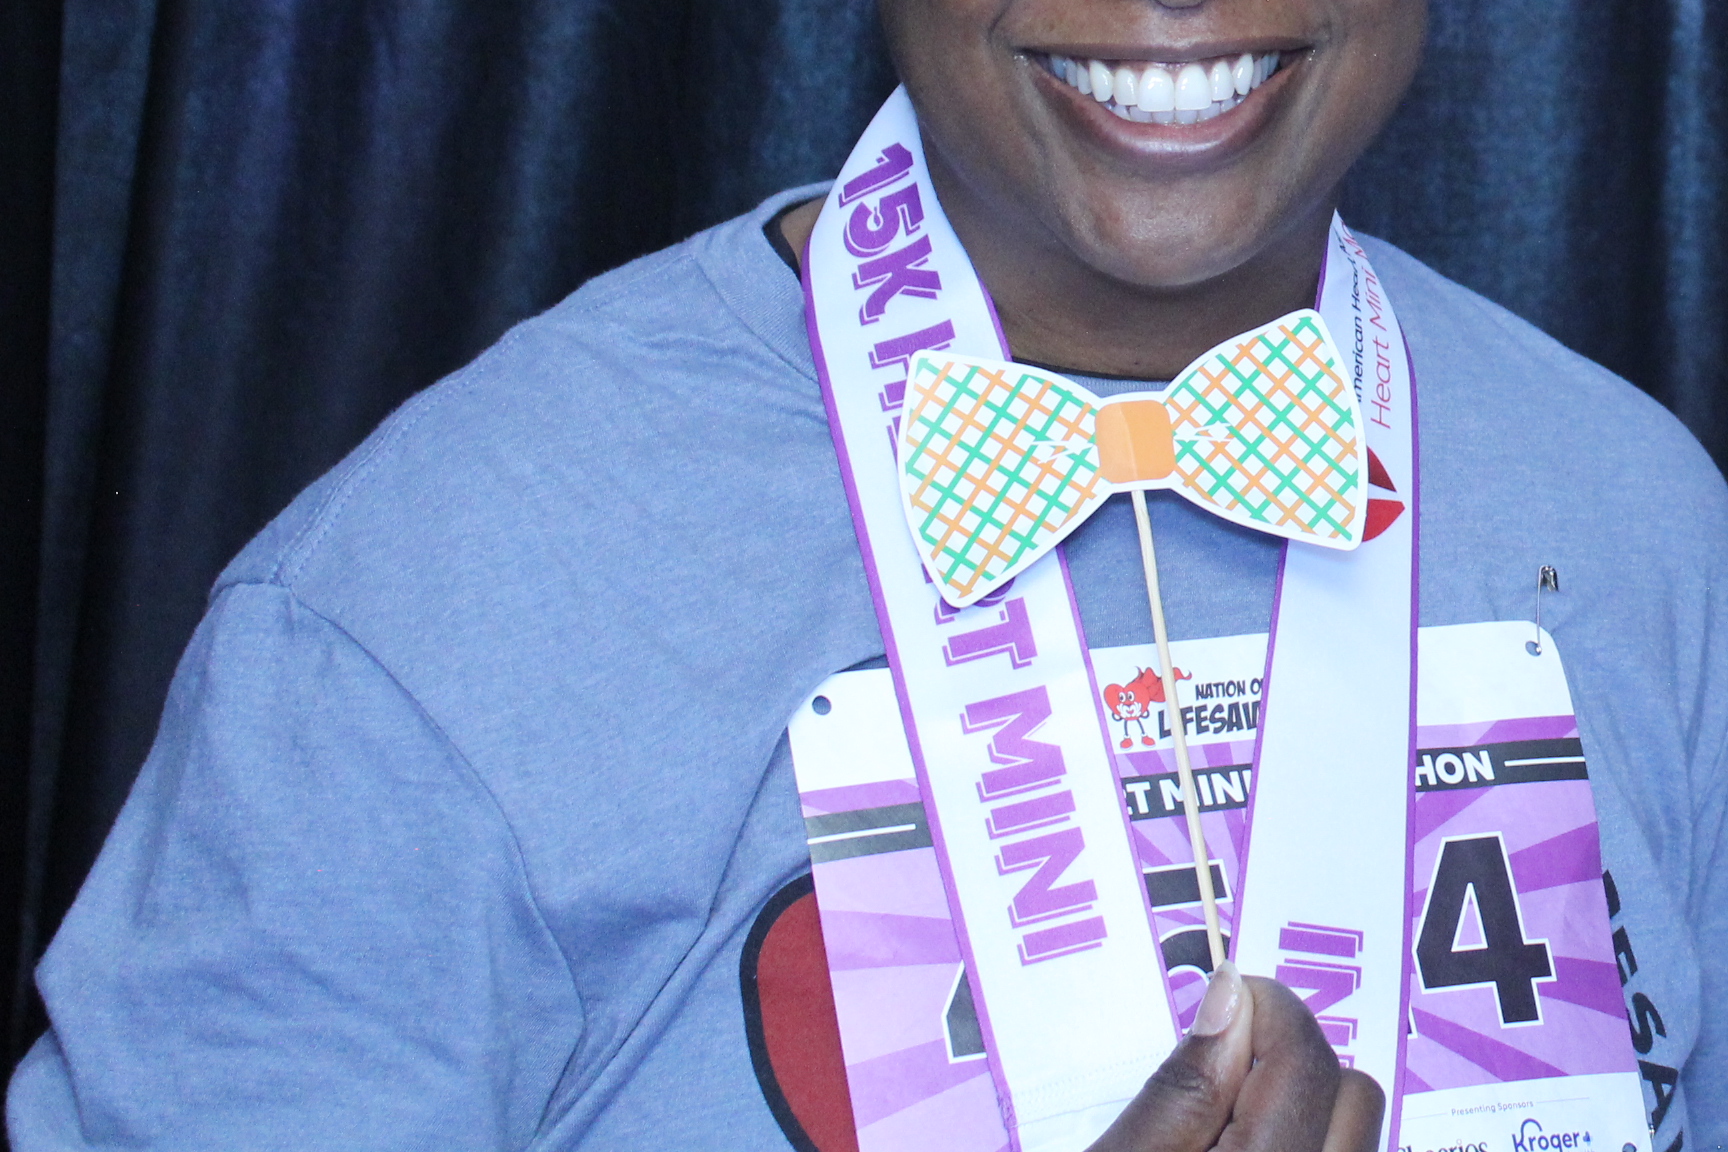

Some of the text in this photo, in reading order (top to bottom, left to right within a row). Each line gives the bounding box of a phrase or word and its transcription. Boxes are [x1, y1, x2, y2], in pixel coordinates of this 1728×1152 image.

[838, 142, 942, 326] 15K
[1351, 315, 1364, 403] merican
[1361, 265, 1391, 429] Heart Mini
[1195, 677, 1263, 701] NATION O
[1415, 750, 1495, 786] HON
[959, 684, 1108, 967] MINI
[1451, 1101, 1534, 1116] Presenting Sponsors
[1511, 1118, 1580, 1152] Kroger
